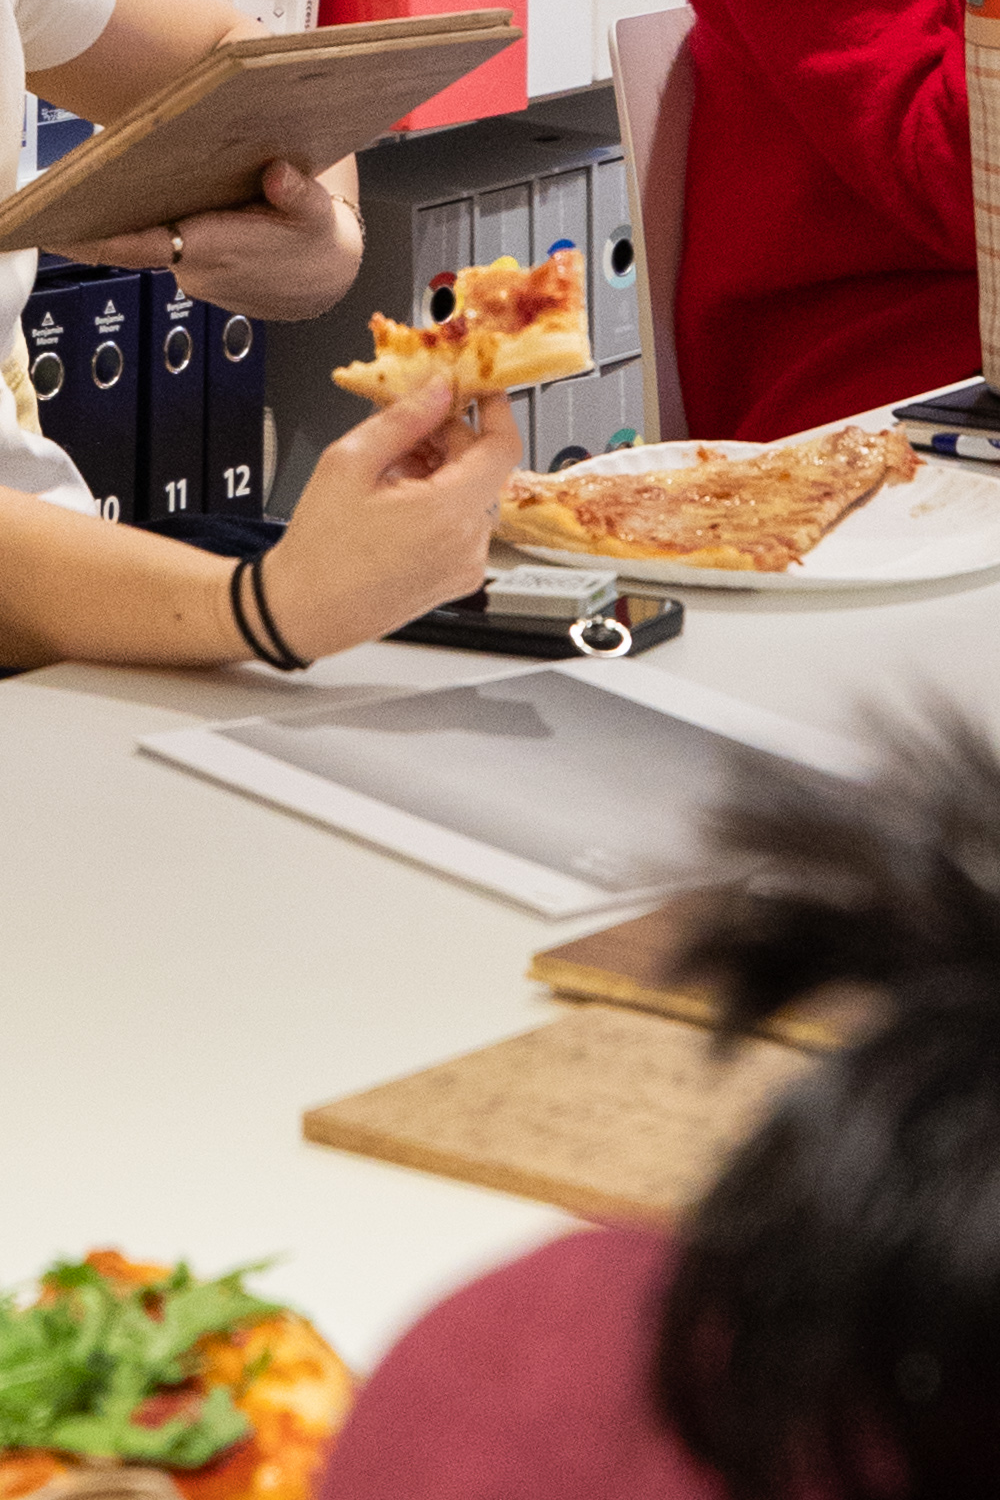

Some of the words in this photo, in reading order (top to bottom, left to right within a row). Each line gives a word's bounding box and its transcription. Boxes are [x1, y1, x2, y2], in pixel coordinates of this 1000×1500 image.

[165, 300, 194, 312] Benjamin
[94, 313, 125, 326] Benjamin
[31, 325, 64, 338] Benjamin
[98, 324, 120, 334] Moore
[36, 335, 59, 346] Moore
[223, 464, 251, 499] 12
[165, 478, 188, 513] 11
[95, 495, 120, 523] 10
